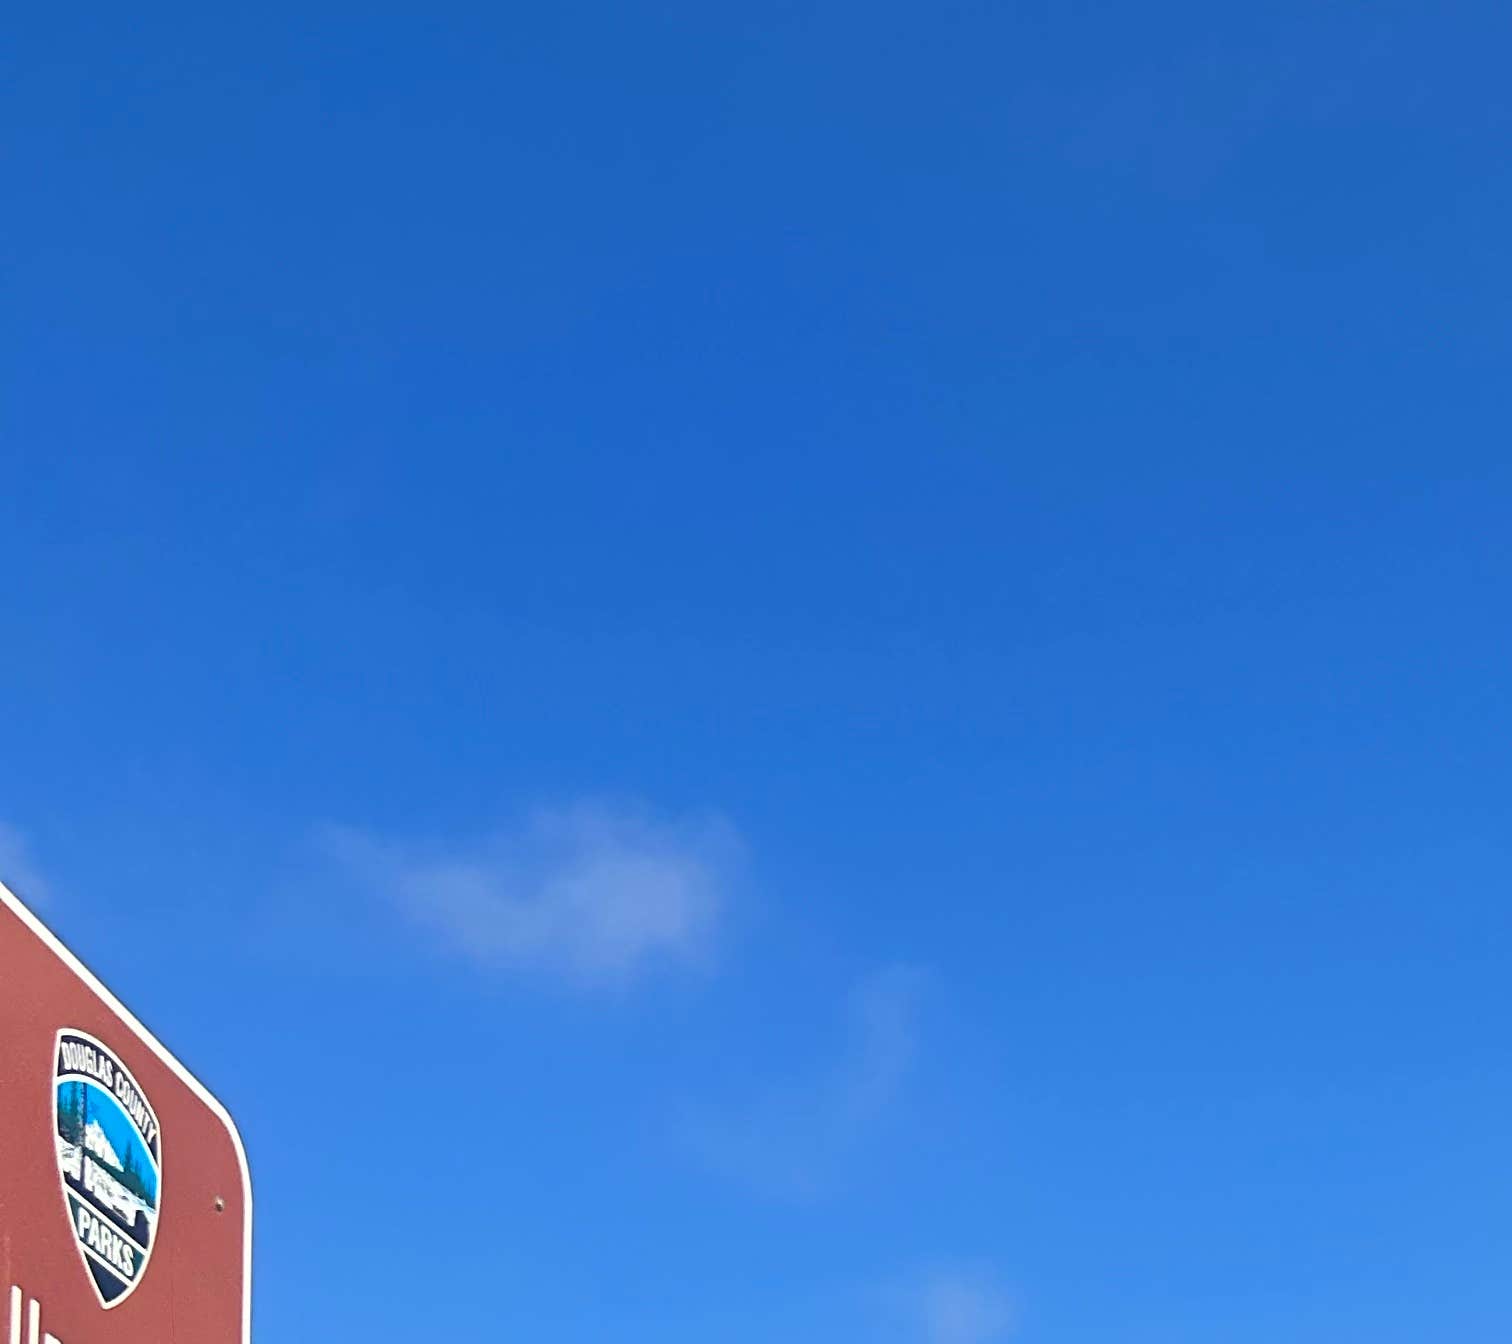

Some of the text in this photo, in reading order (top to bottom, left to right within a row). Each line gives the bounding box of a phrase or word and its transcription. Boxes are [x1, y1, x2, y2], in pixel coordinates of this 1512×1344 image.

[60, 1041, 157, 1144] DOUGLAS COUNTY
[77, 1206, 135, 1278] PARKS
